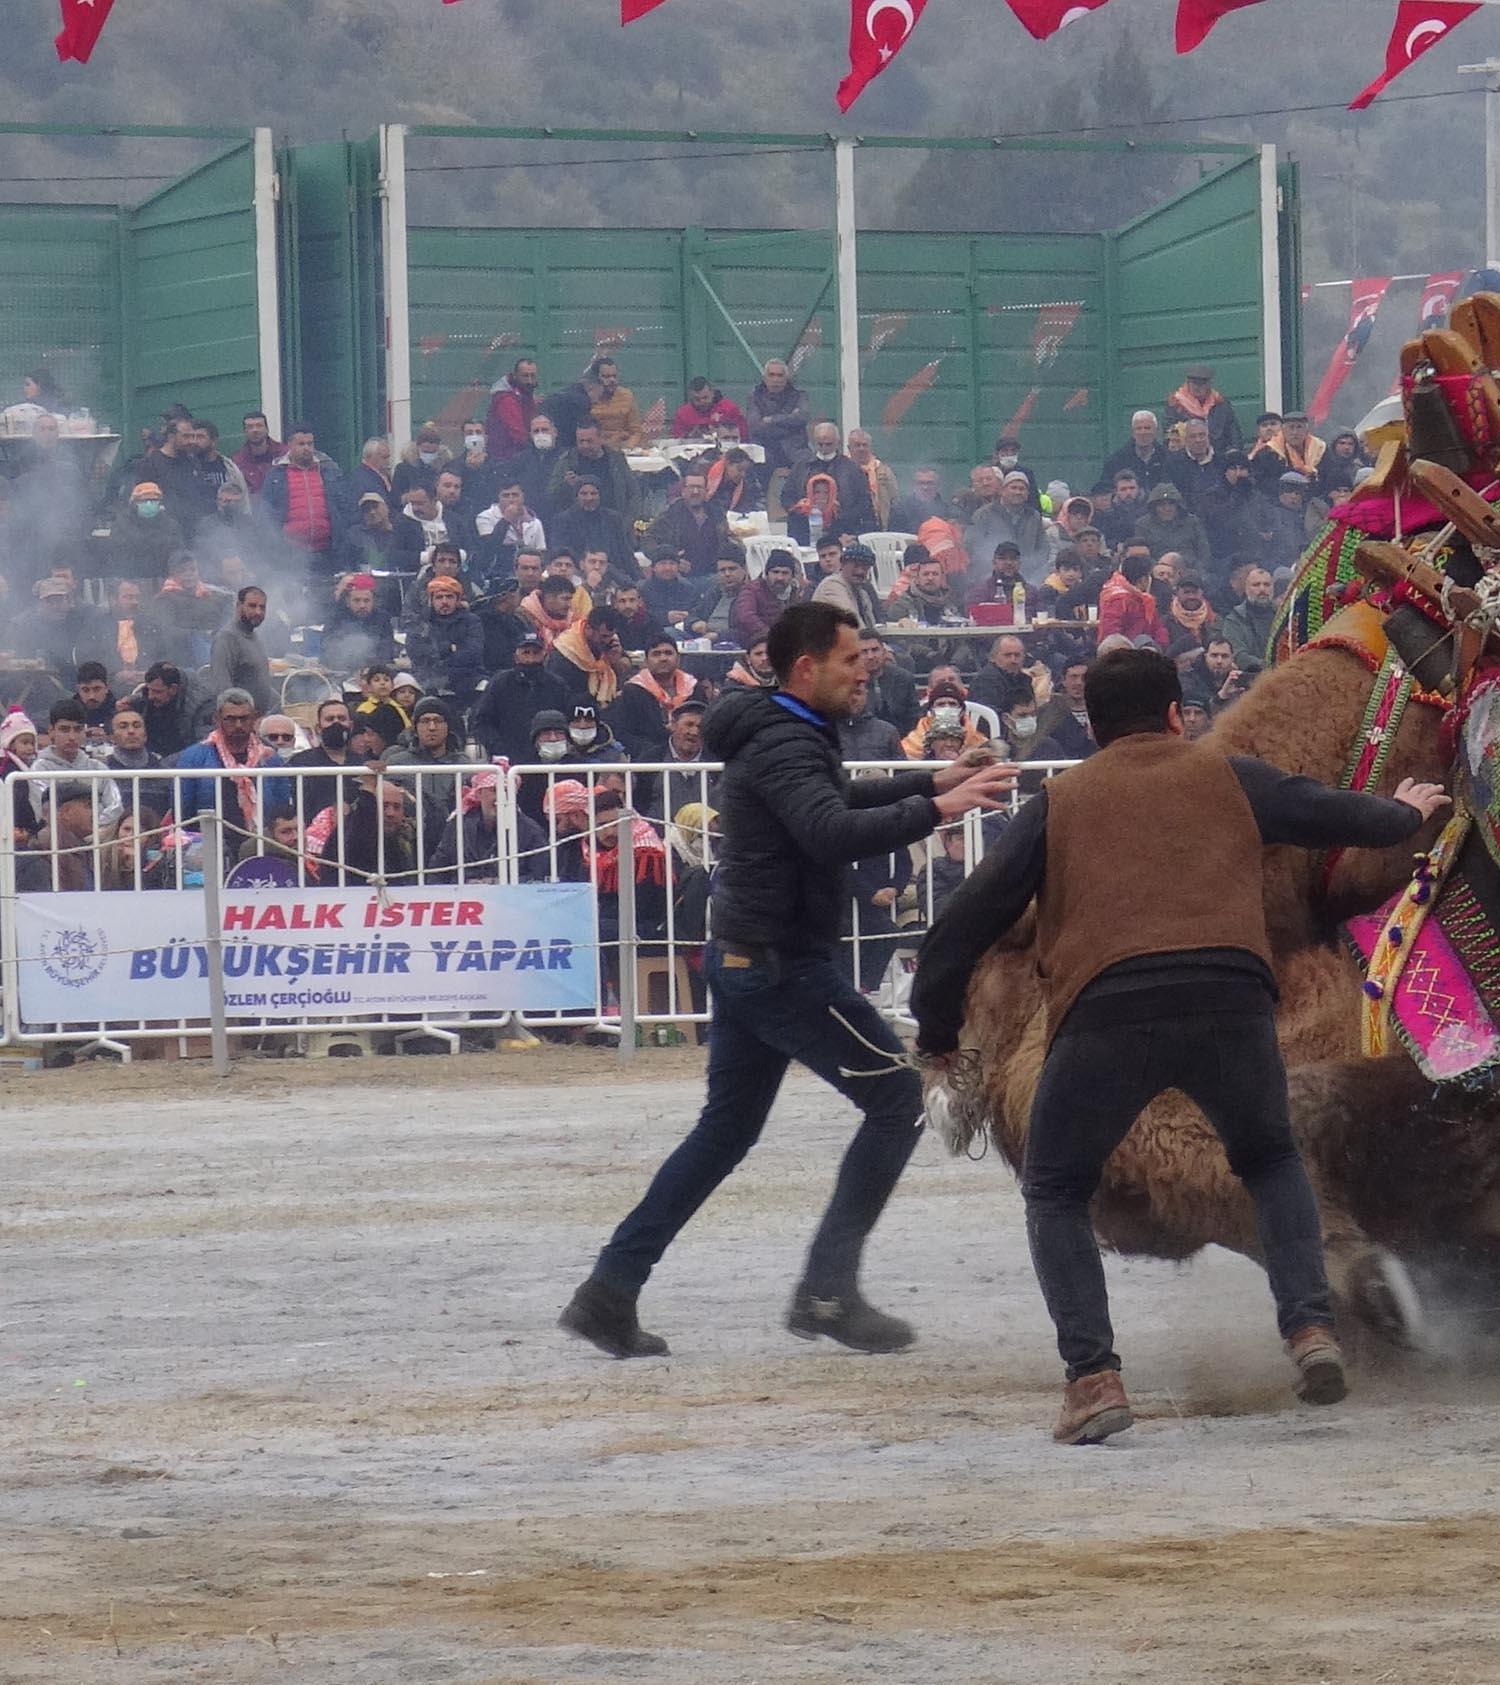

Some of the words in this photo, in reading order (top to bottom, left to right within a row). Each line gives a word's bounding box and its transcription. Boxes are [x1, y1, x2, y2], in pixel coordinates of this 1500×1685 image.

[223, 903, 346, 930] HALK
[364, 895, 485, 928] İSTER
[430, 939, 573, 972] YAPAR
[270, 989, 351, 1009] ÇERÇİOĞLU
